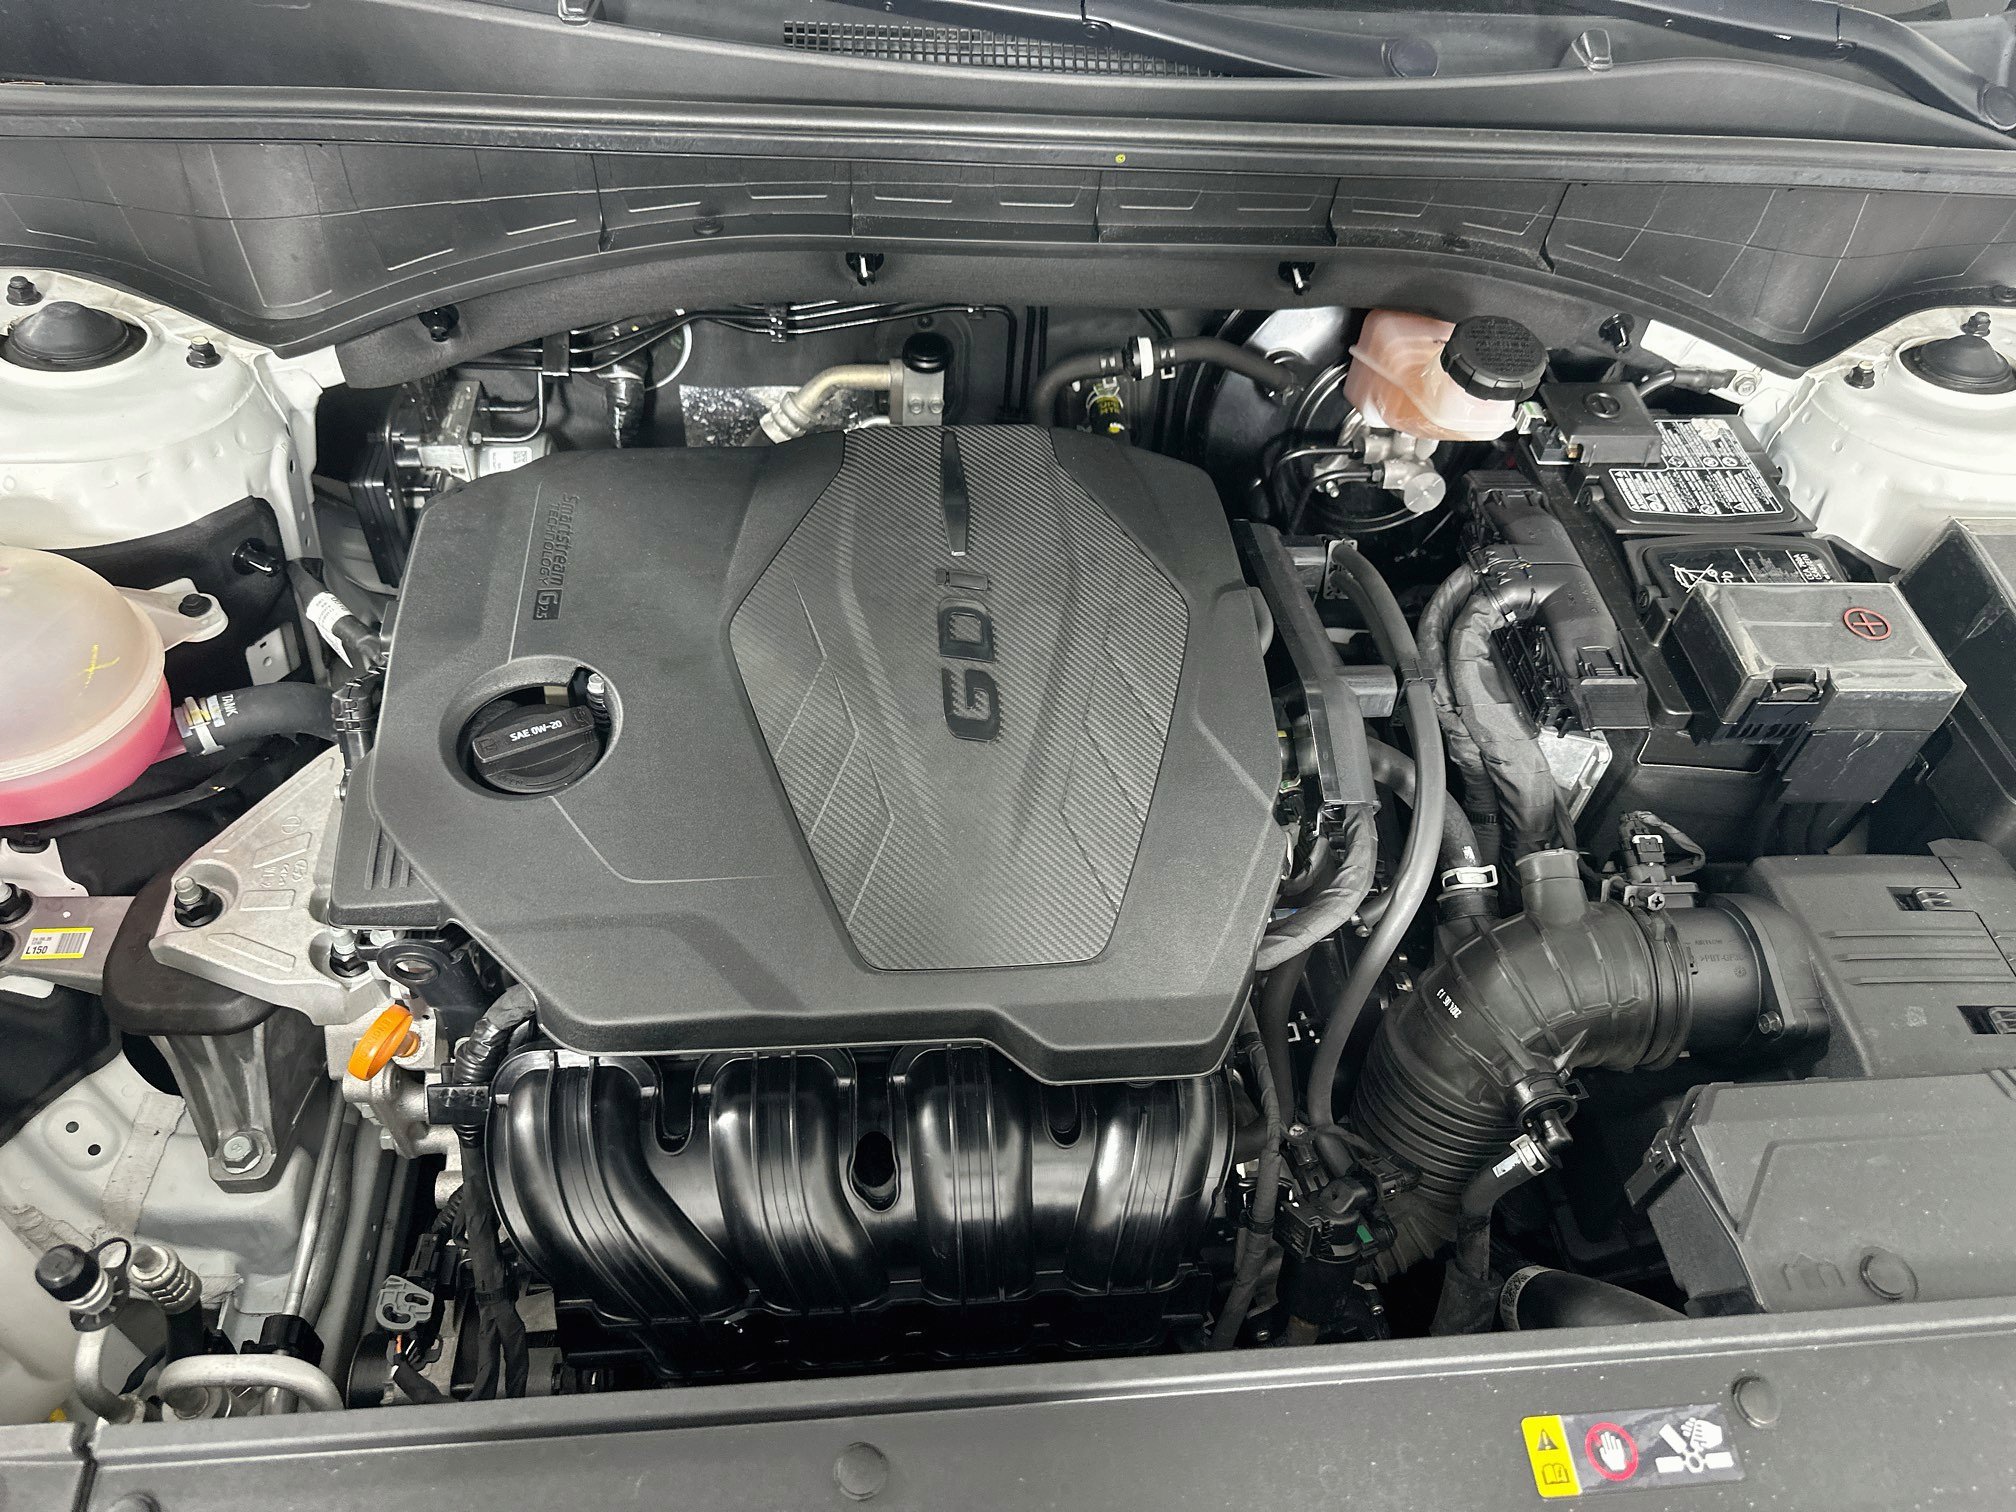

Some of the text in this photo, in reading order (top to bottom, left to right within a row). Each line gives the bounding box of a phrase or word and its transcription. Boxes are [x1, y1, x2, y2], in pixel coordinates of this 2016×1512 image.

[539, 503, 560, 586] TECHNOLOGY
[549, 492, 580, 586] Smartstream
[935, 568, 1001, 744] GDi
[221, 694, 239, 718] TANK
[509, 719, 563, 742] SAE 0W-20
[25, 945, 48, 955] L150
